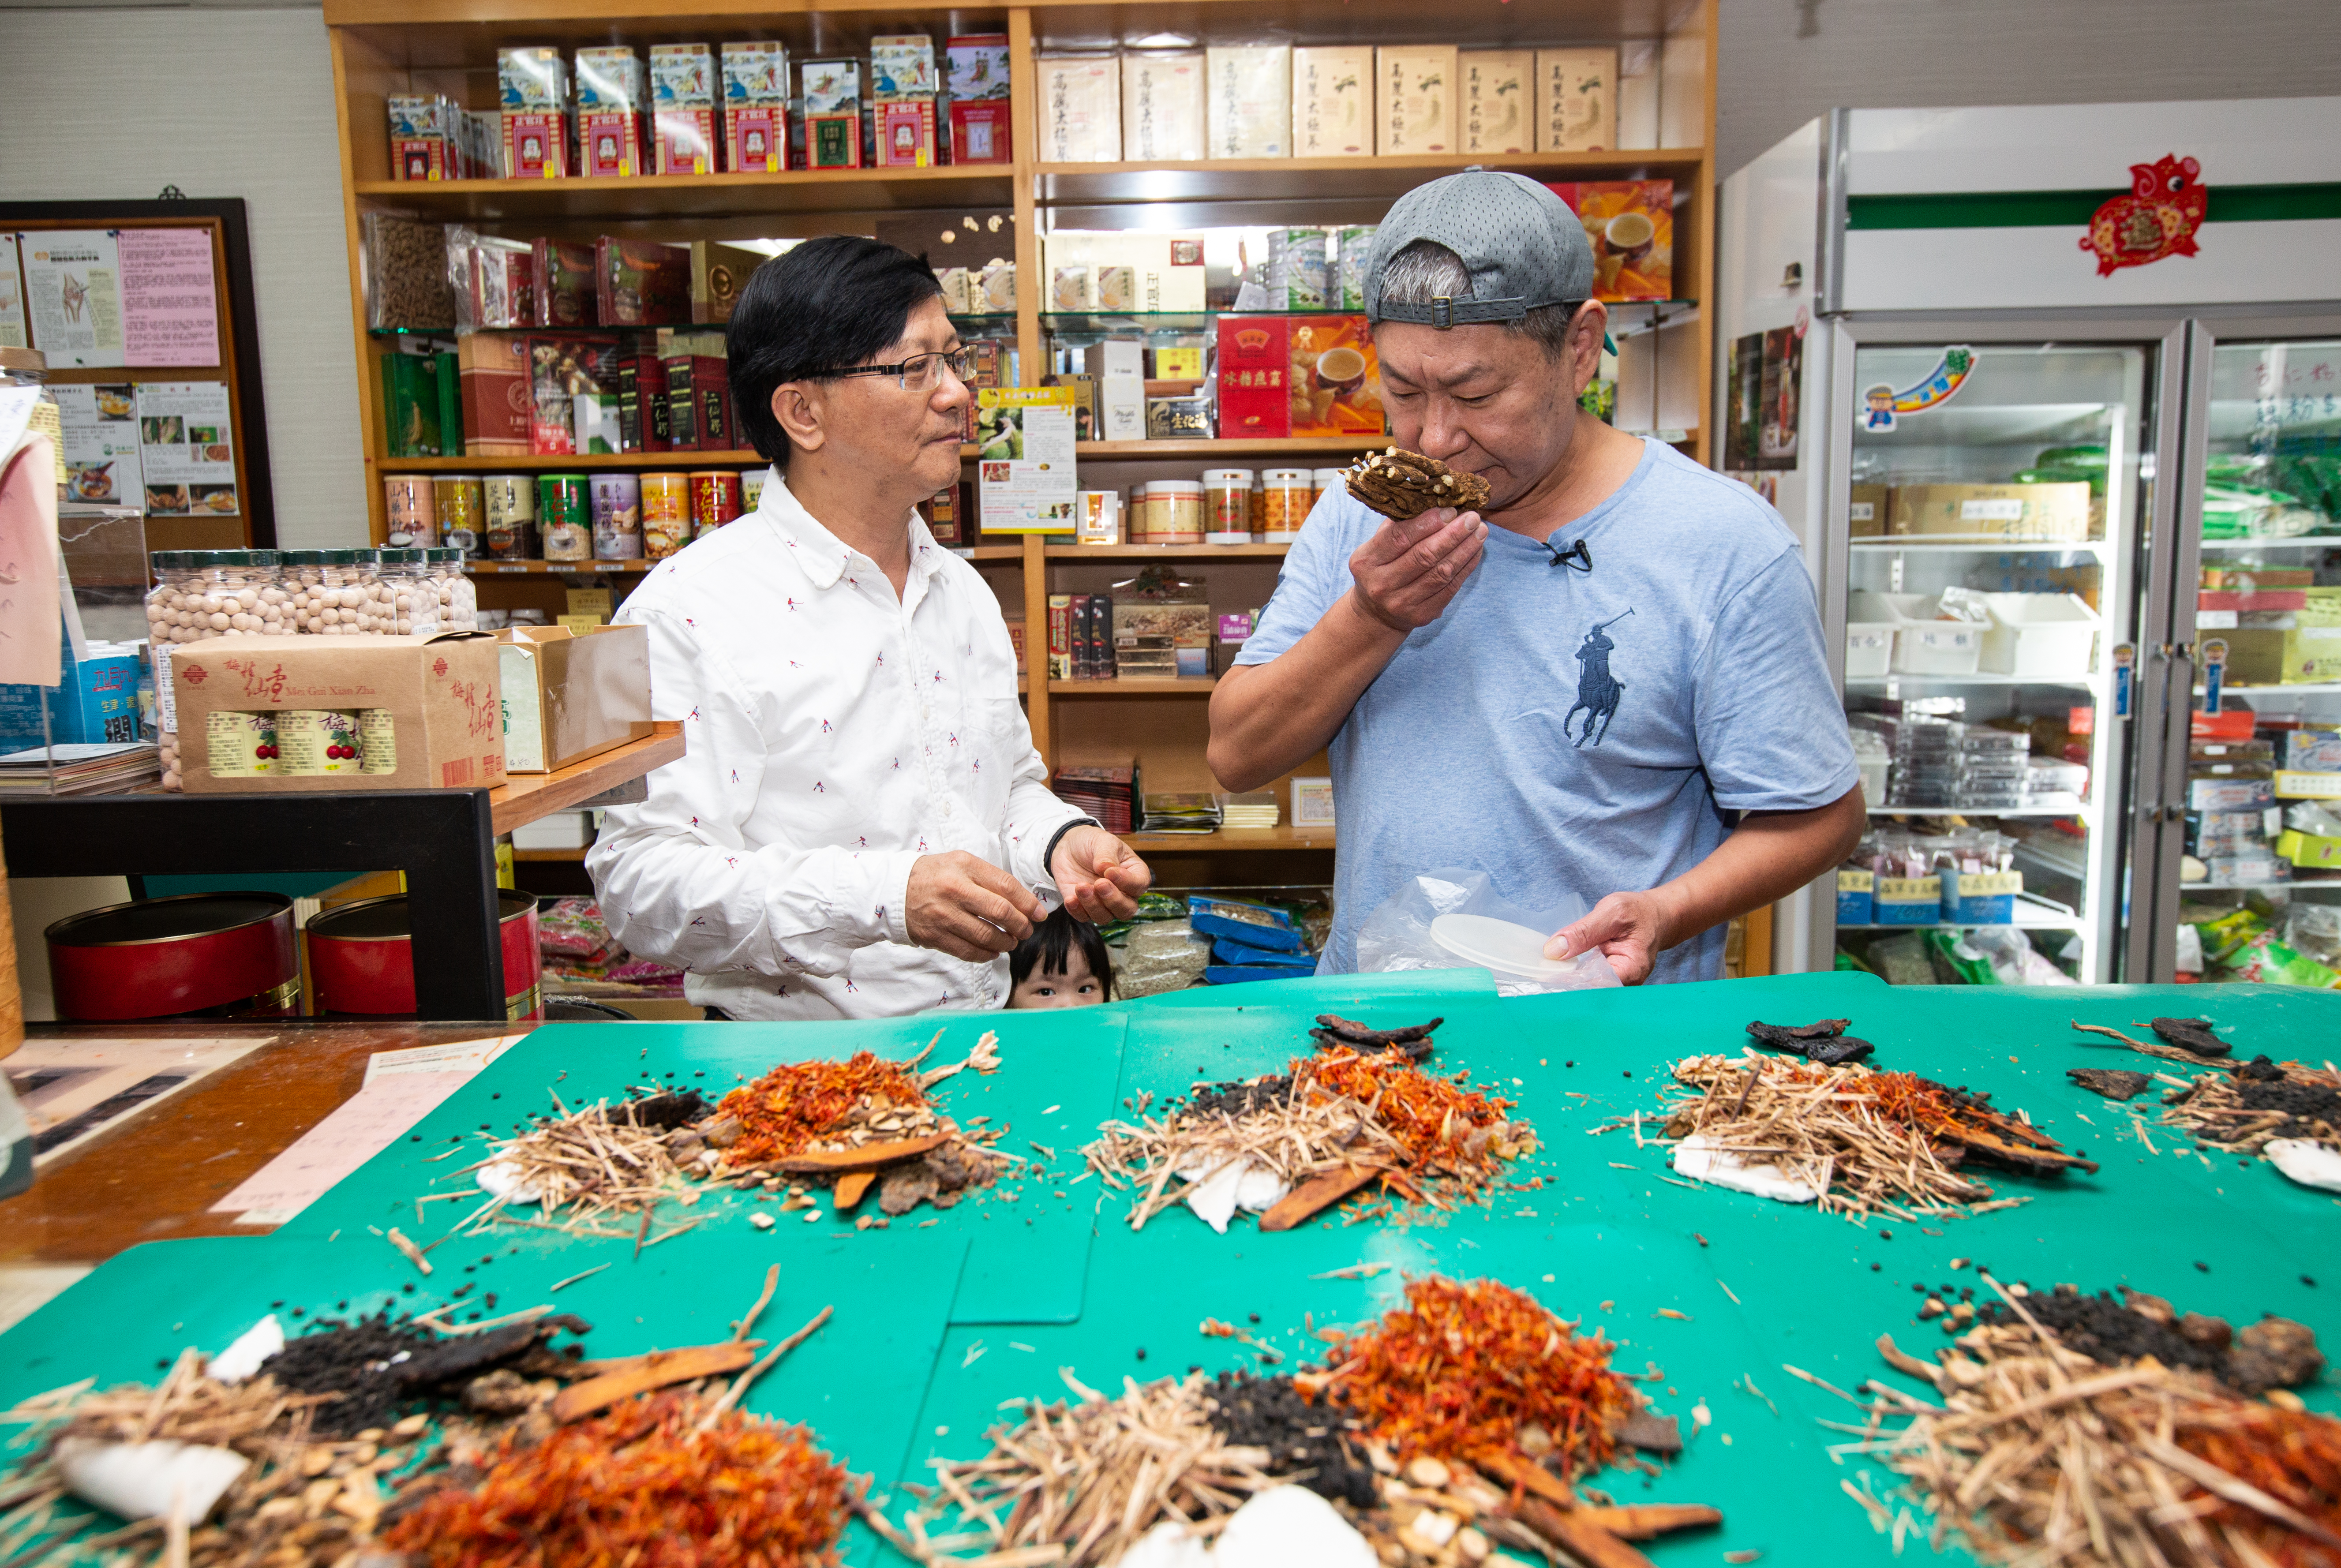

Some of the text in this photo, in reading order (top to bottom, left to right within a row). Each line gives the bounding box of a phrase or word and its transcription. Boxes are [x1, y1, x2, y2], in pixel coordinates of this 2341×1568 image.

[286, 685, 375, 696] Mei Gui Xian Zha
